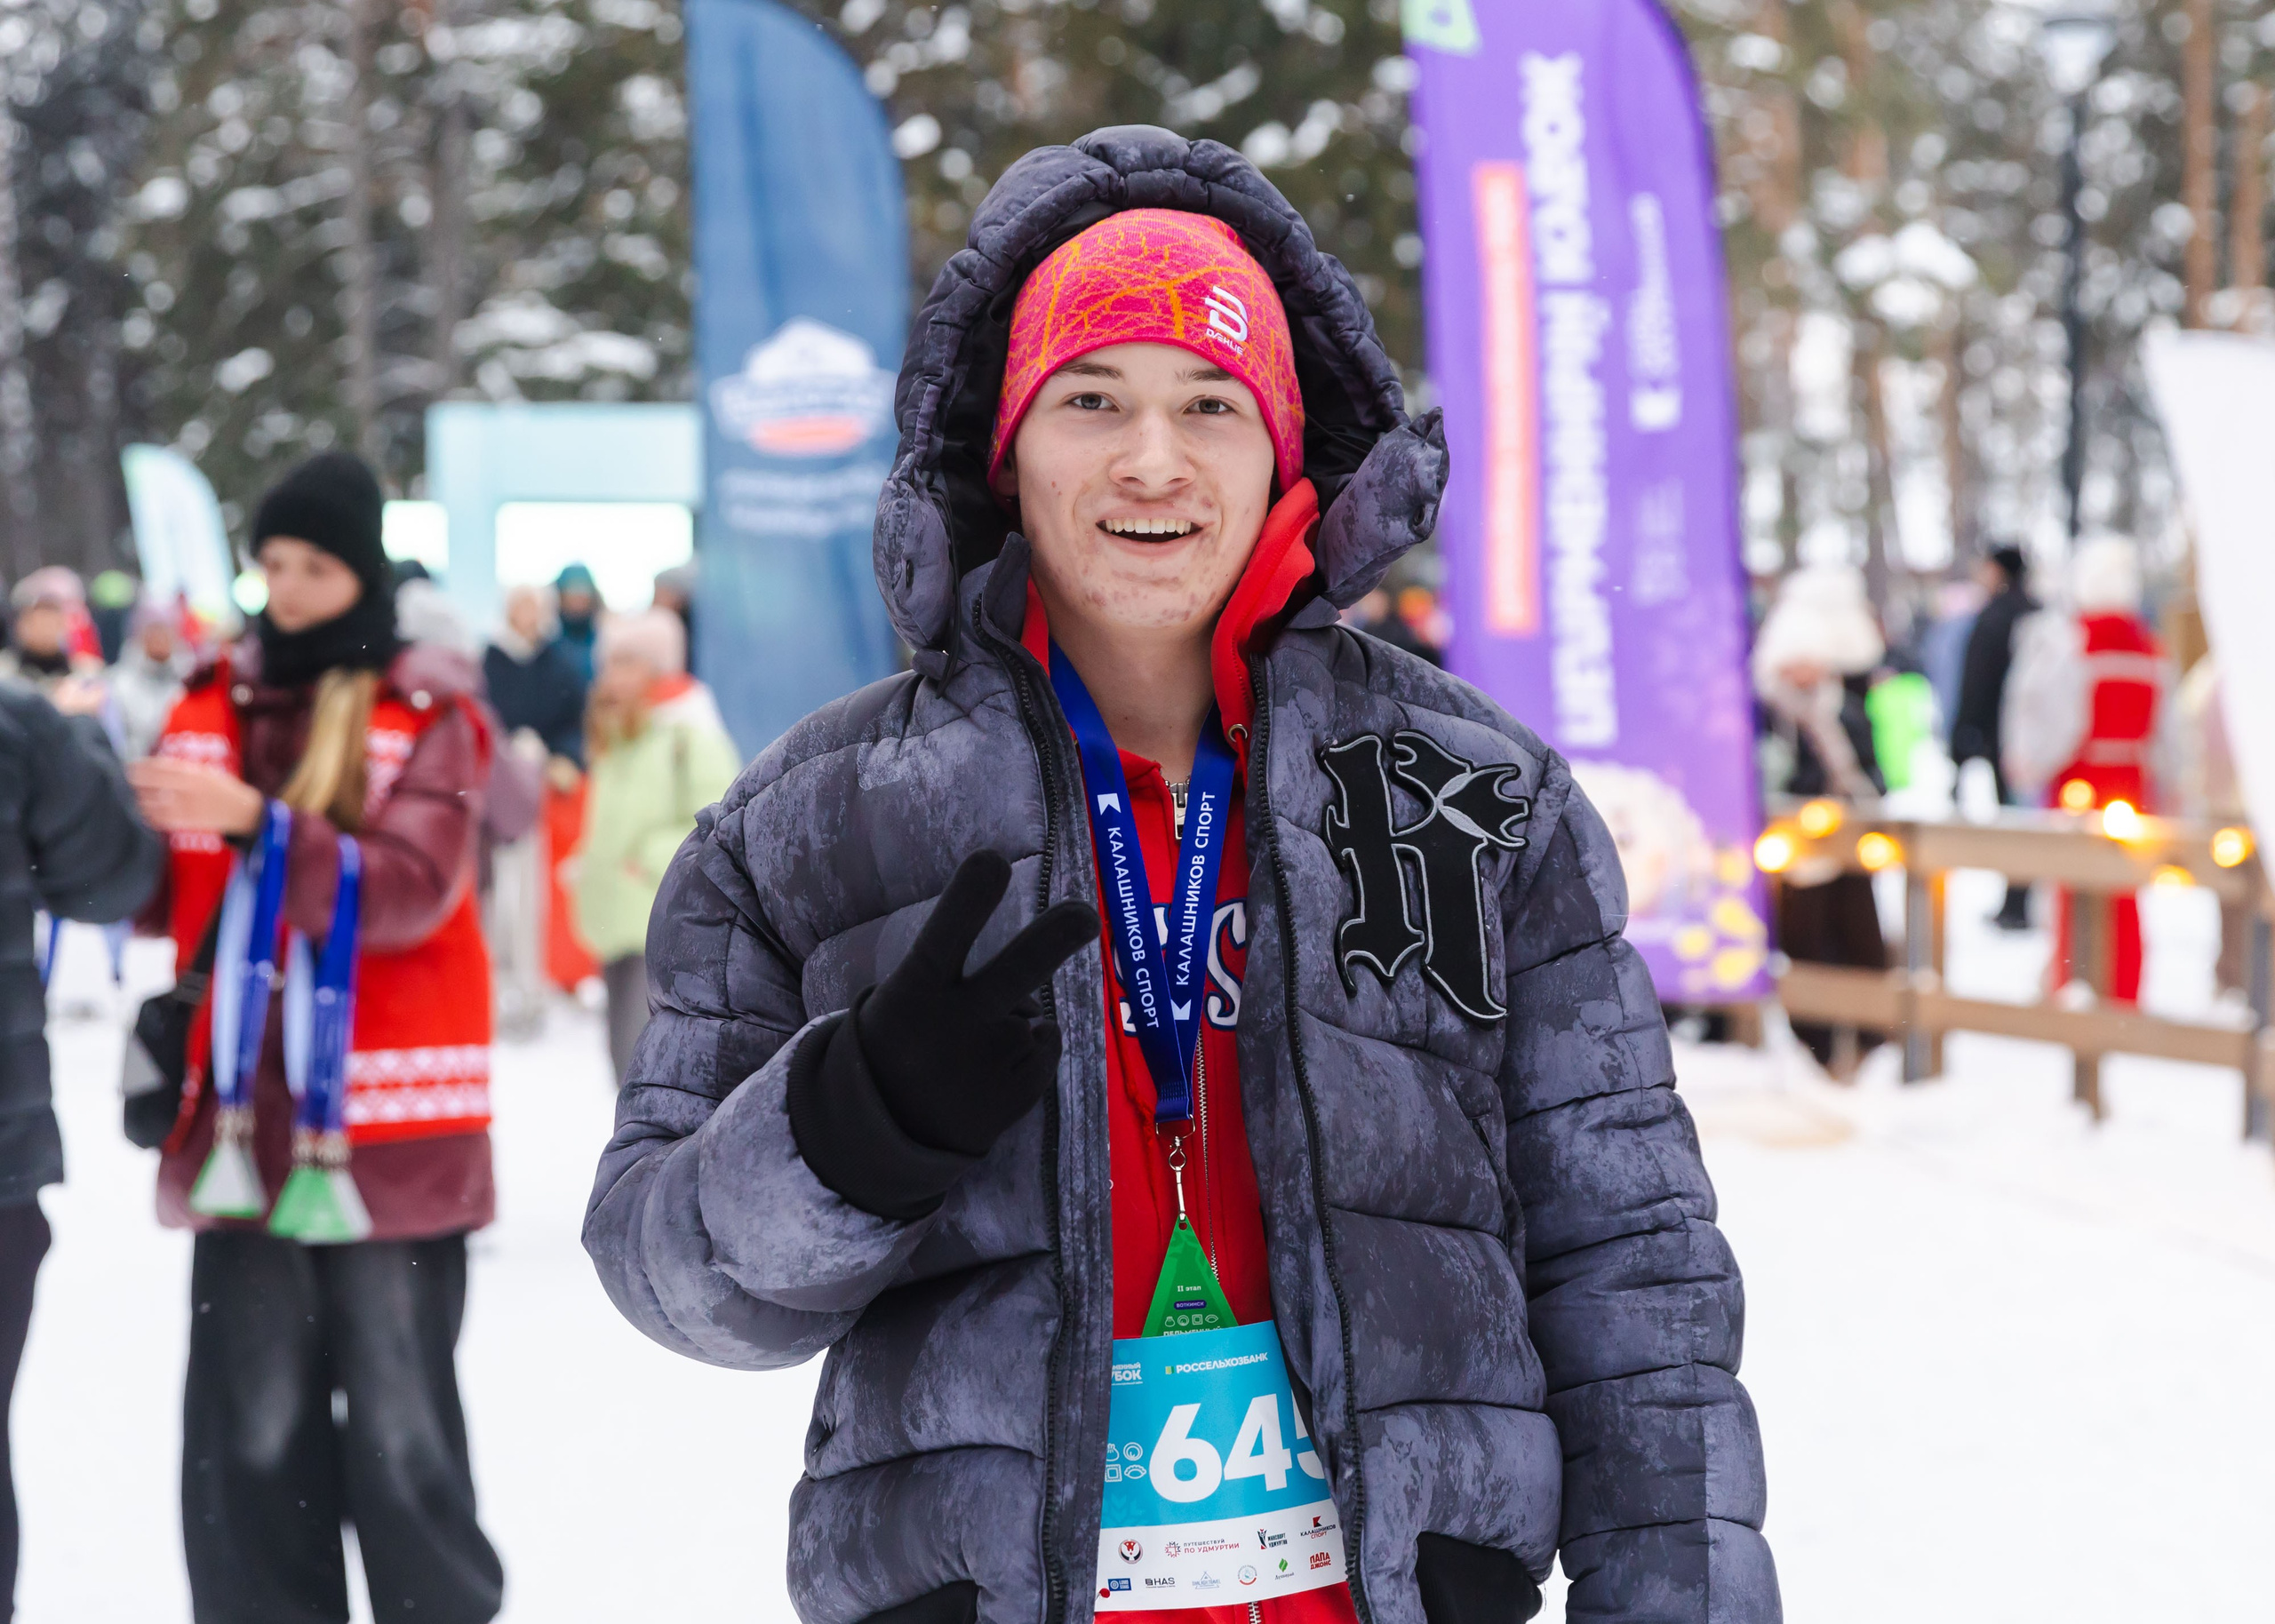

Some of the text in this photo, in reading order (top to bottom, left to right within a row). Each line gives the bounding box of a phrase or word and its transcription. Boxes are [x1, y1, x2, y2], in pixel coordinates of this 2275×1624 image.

[1176, 791, 1216, 986] КАЛАШНИКОВ СПОРТ
[1107, 826, 1160, 1029] КАЛАШНИКОВ СПОРТ
[1175, 1351, 1269, 1374] РОССЕЛЬХОЗБАНК
[1299, 1524, 1337, 1537] КАЛАШНИКОВ
[1310, 1531, 1328, 1540] СПОРТ
[1183, 1538, 1225, 1548] ПУТЕШЕСТВУЙ
[1197, 1542, 1240, 1554] УДМУРТИИ
[1309, 1551, 1331, 1564] ПАПА
[1310, 1559, 1332, 1571] ДЖОНС
[1153, 1577, 1176, 1586] HAS
